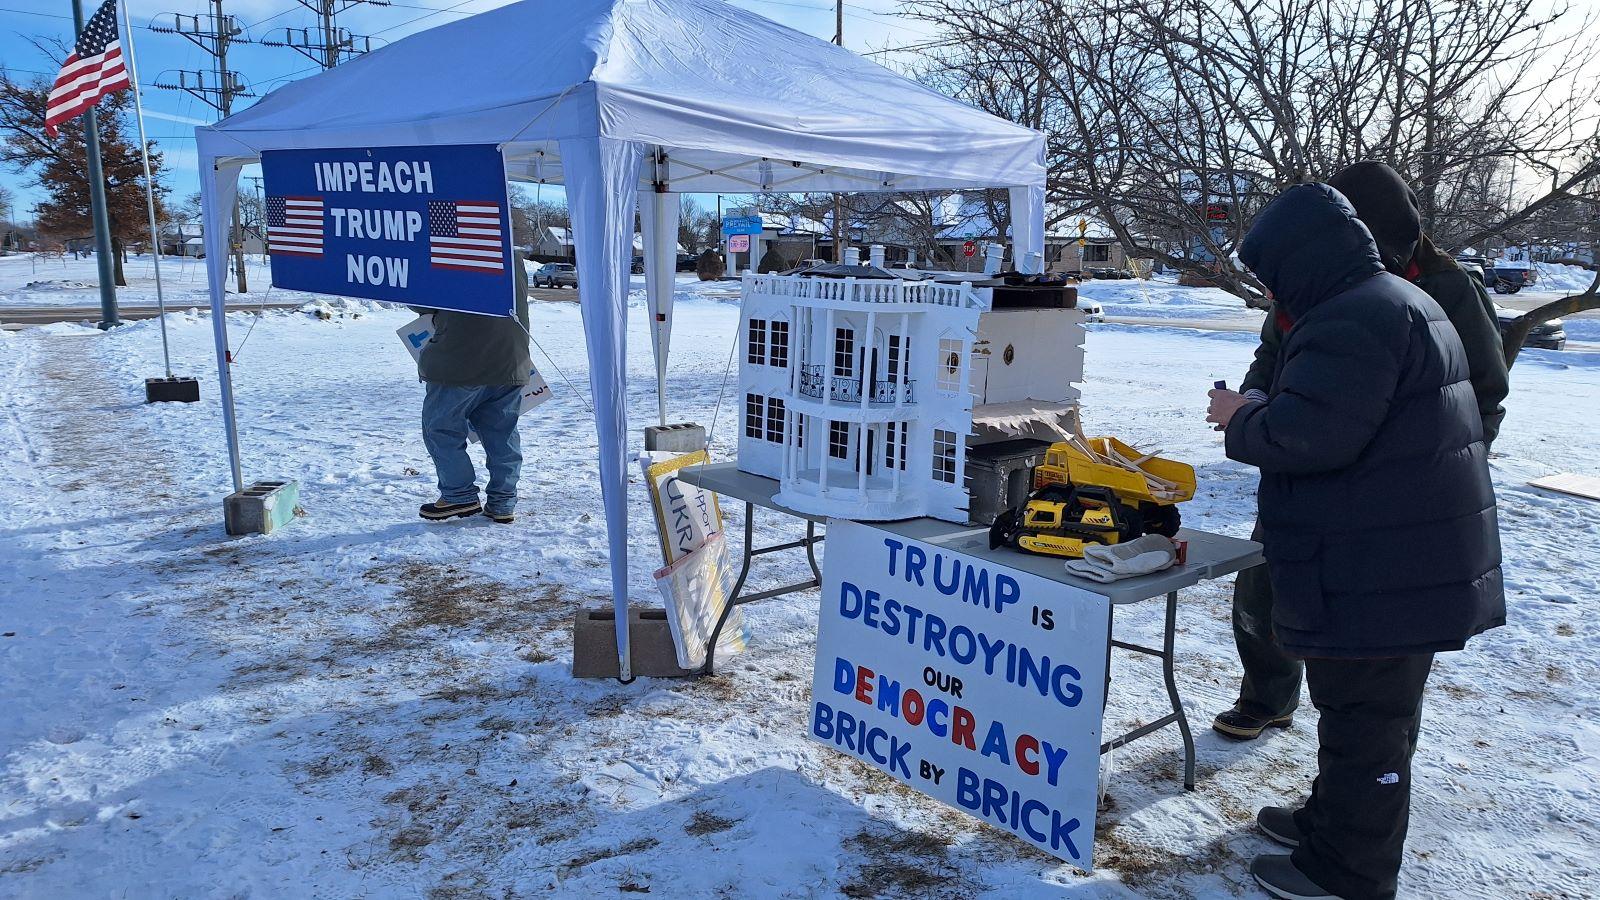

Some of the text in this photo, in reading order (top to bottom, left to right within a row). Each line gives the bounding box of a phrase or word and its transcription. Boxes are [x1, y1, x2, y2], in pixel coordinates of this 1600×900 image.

[314, 161, 434, 194] IMPEACH
[330, 208, 423, 242] TRUMP
[725, 219, 751, 228] PREVAIL
[347, 254, 409, 289] NOW
[694, 485, 717, 539] upport
[884, 538, 1055, 631] TRUMP IS
[839, 581, 1084, 708] DESTROYING
[922, 666, 963, 700] OUR
[833, 656, 1068, 787] DEMOCRACY
[813, 701, 1082, 861] BRICK BY BRICK
